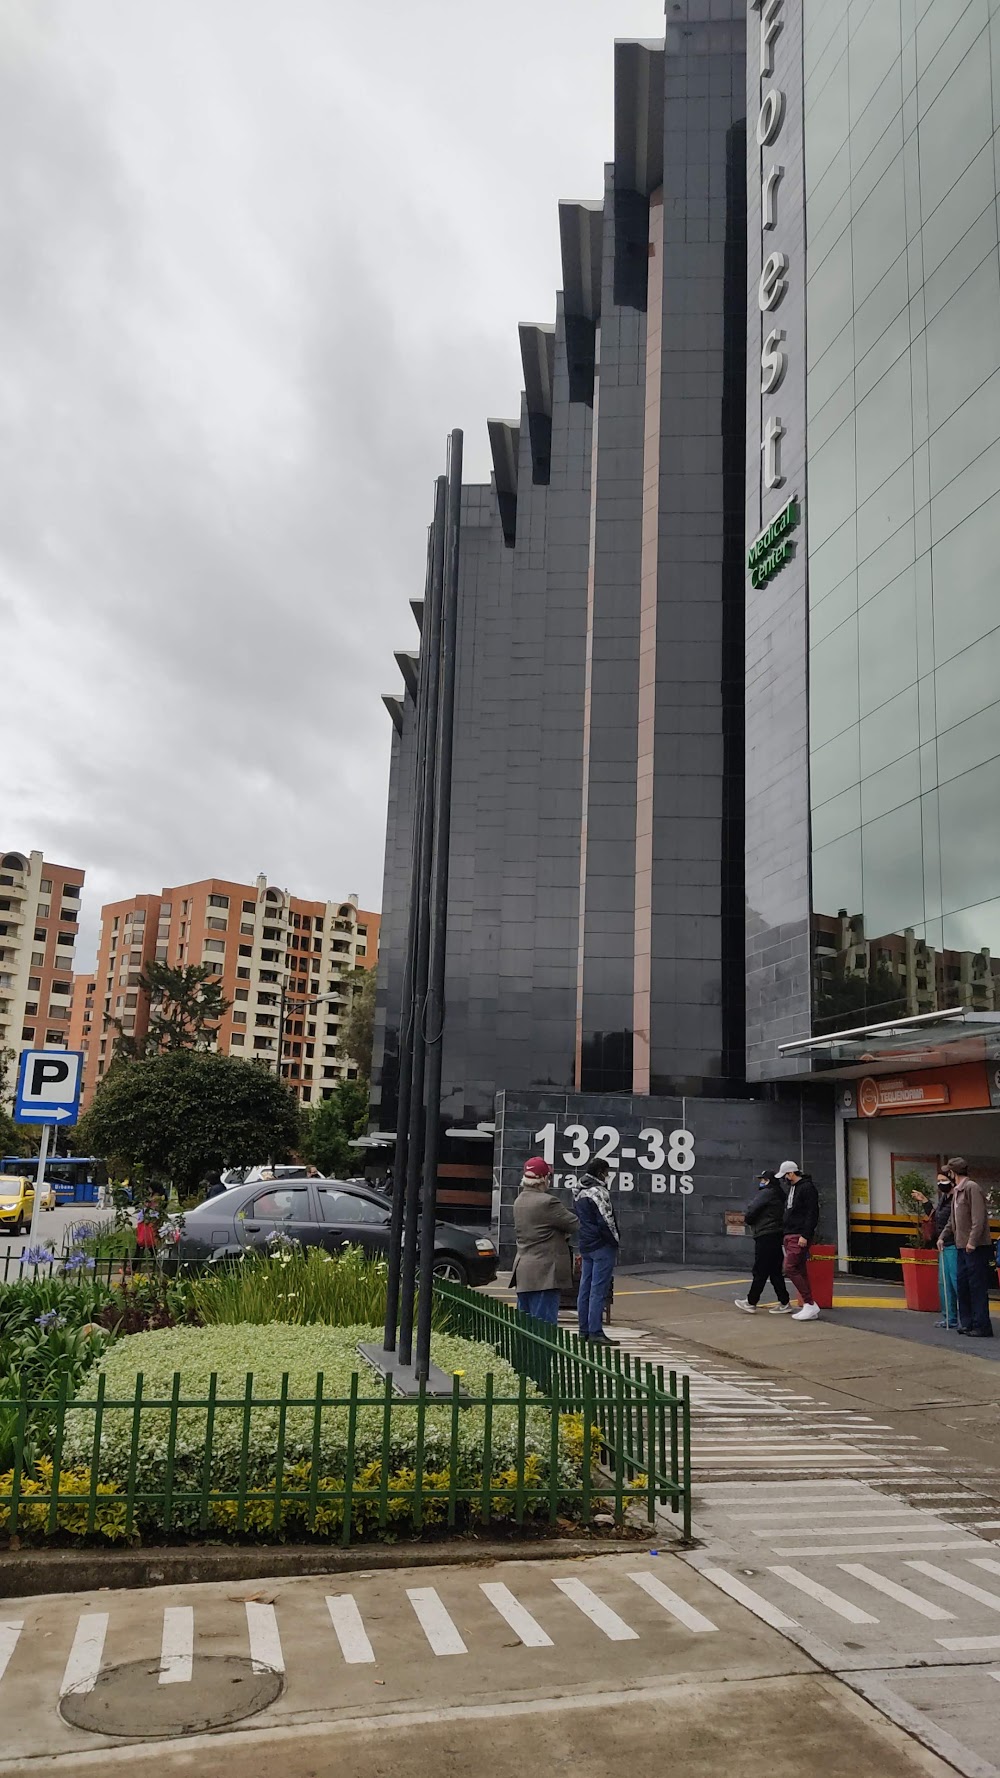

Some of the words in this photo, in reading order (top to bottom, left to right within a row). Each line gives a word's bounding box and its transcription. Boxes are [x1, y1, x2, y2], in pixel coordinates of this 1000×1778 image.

[747, 503, 791, 566] Medical
[752, 540, 789, 588] Center
[31, 1058, 69, 1095] P
[534, 1123, 695, 1172] 132-38
[651, 1174, 694, 1195] BIS
